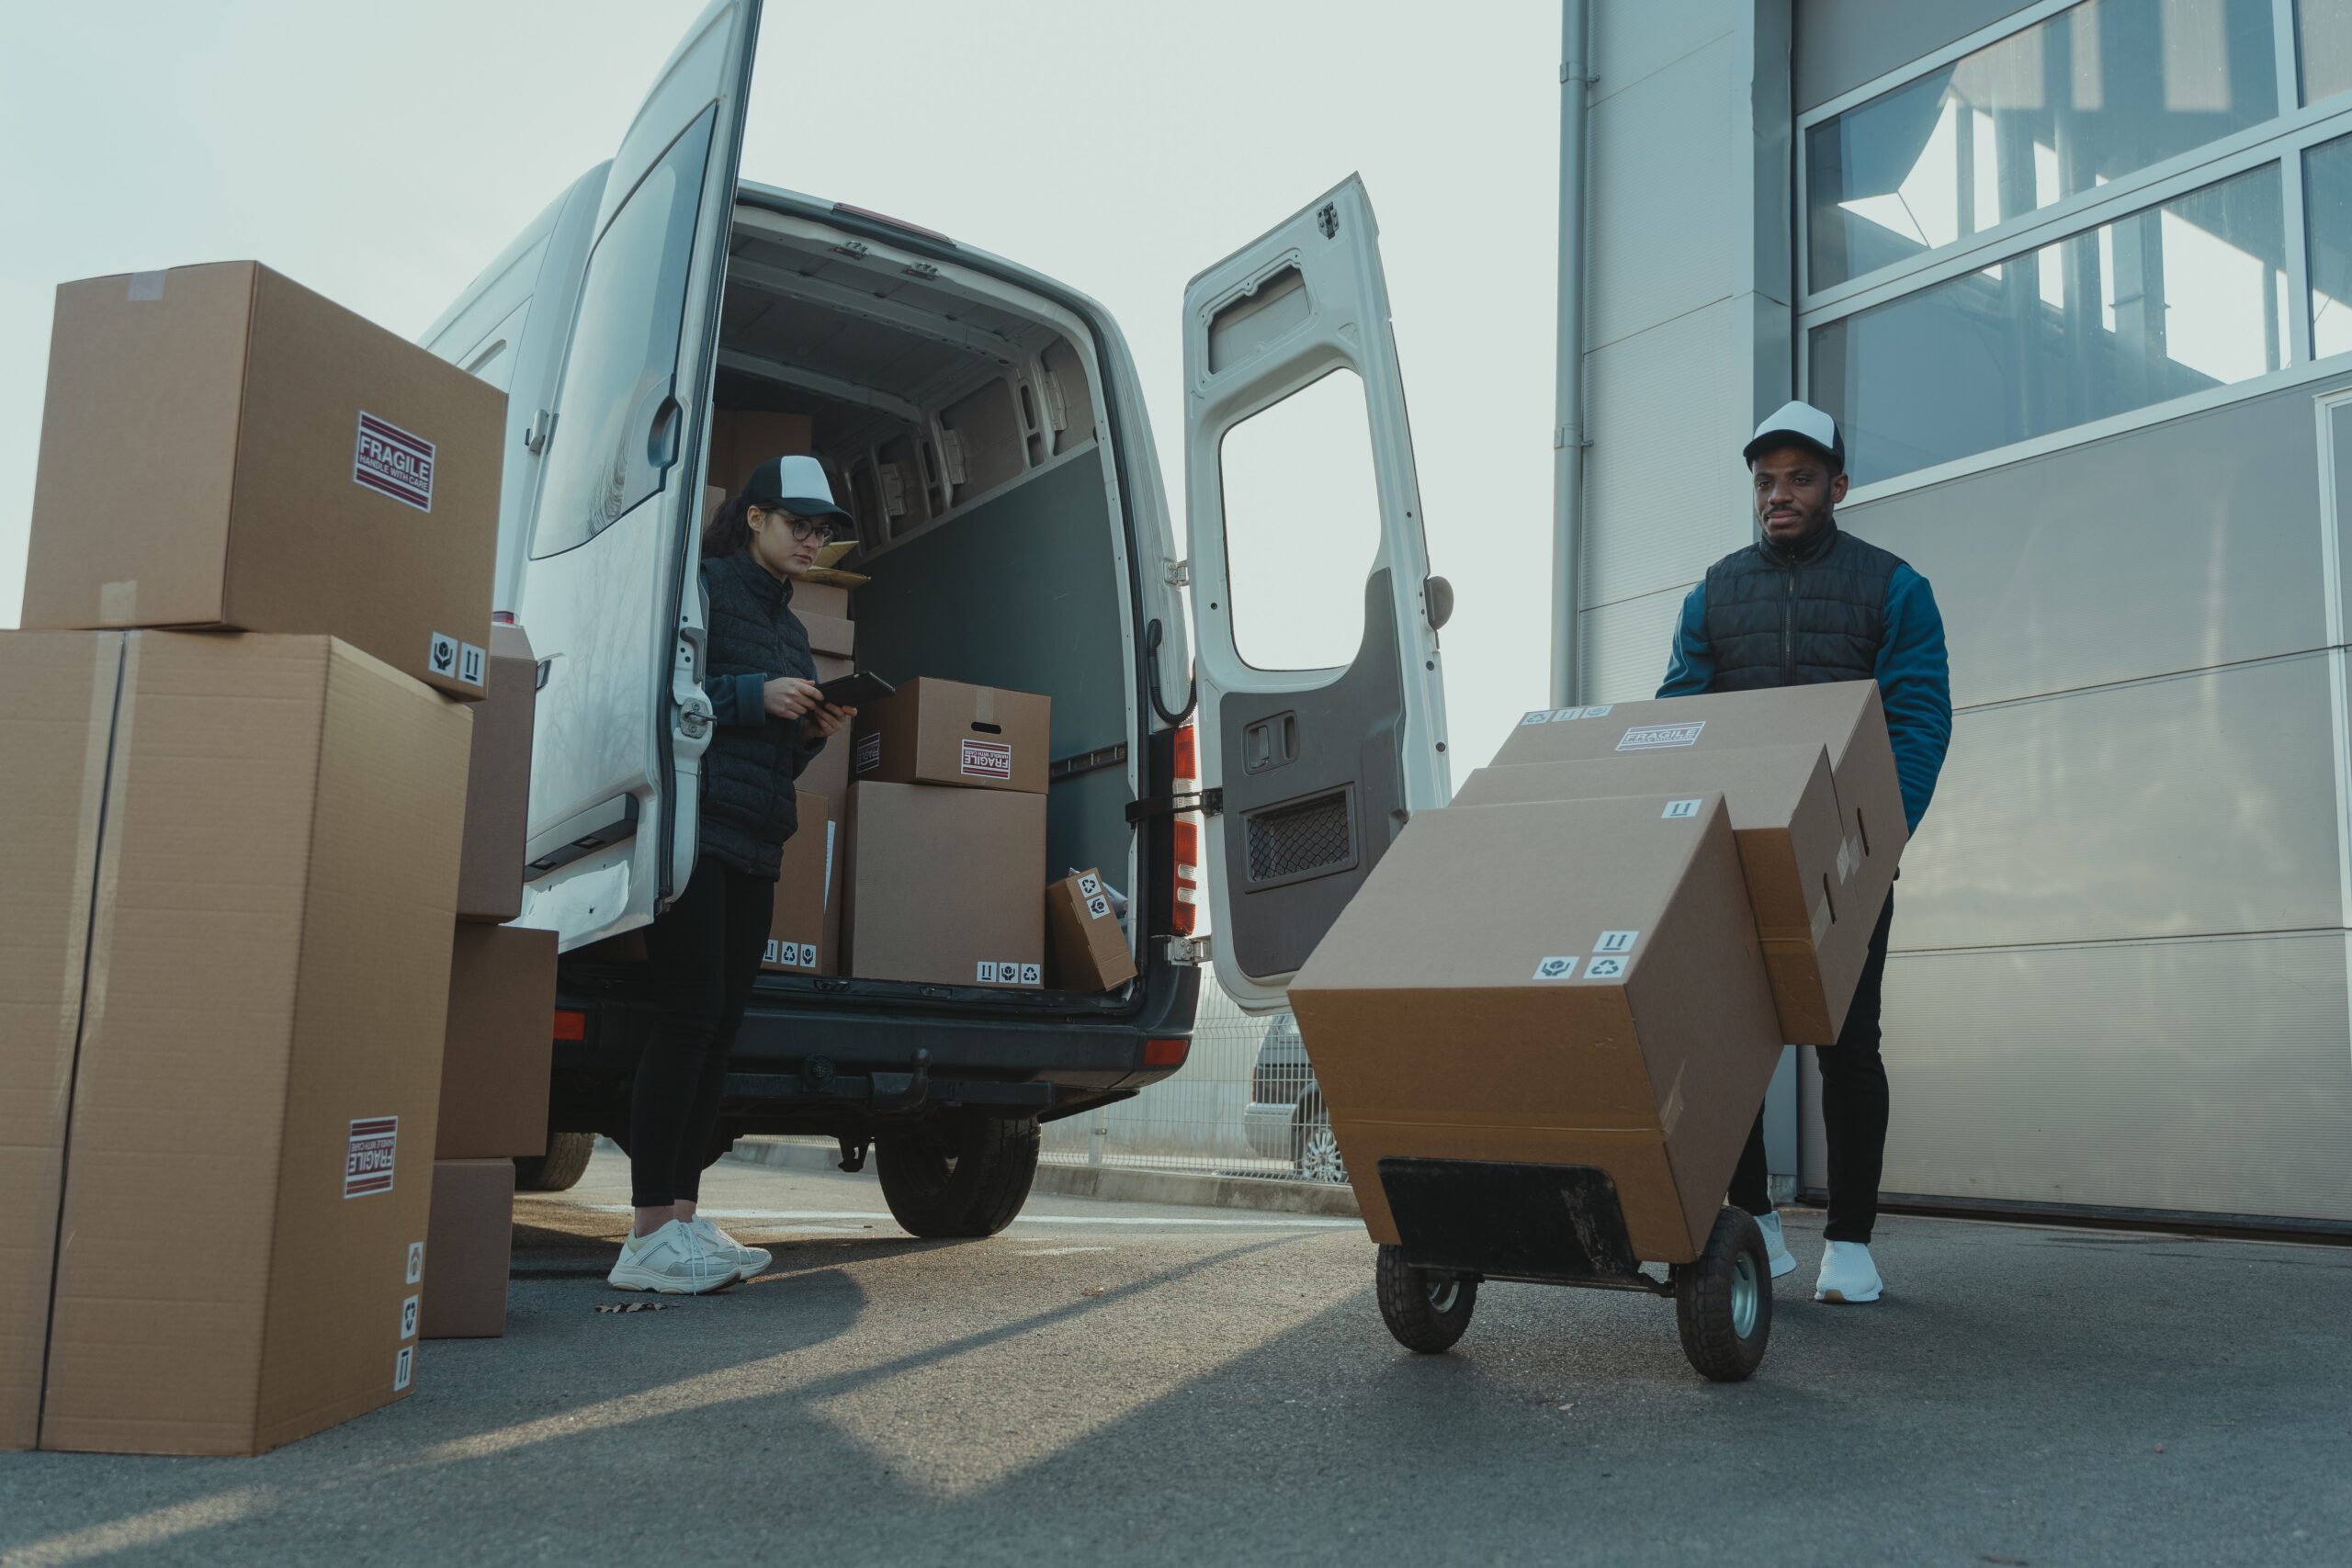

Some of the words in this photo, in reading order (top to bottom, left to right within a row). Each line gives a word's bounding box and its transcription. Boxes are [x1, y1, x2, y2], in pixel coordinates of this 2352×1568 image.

[359, 434, 430, 482] FRAGILE
[359, 454, 389, 474] HANDLE
[390, 467, 409, 482] WITH
[409, 476, 429, 491] CARE
[1625, 728, 1698, 741] FRAGILE
[965, 754, 1008, 769] FRAGILE
[351, 1142, 365, 1152] CARE
[366, 1141, 376, 1150] WITH
[349, 1147, 393, 1173] FRAGILE
